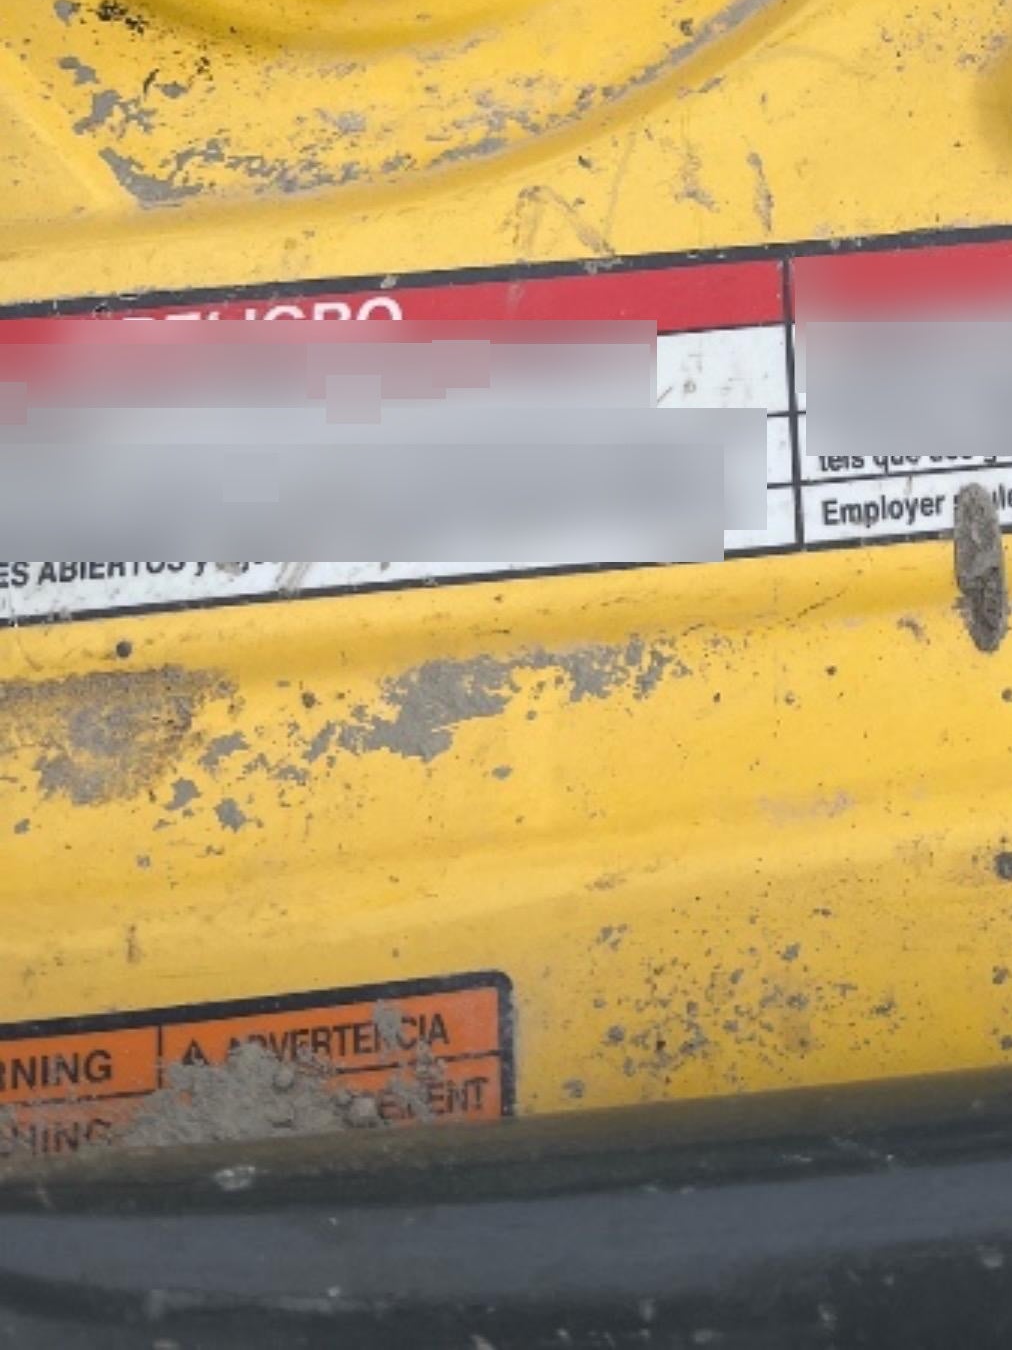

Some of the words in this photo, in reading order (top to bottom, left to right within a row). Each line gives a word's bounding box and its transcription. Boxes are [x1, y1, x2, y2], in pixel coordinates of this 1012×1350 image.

[822, 495, 945, 527] Employer
[228, 1012, 450, 1063] VERTECIA
[0, 1049, 112, 1090] NING
